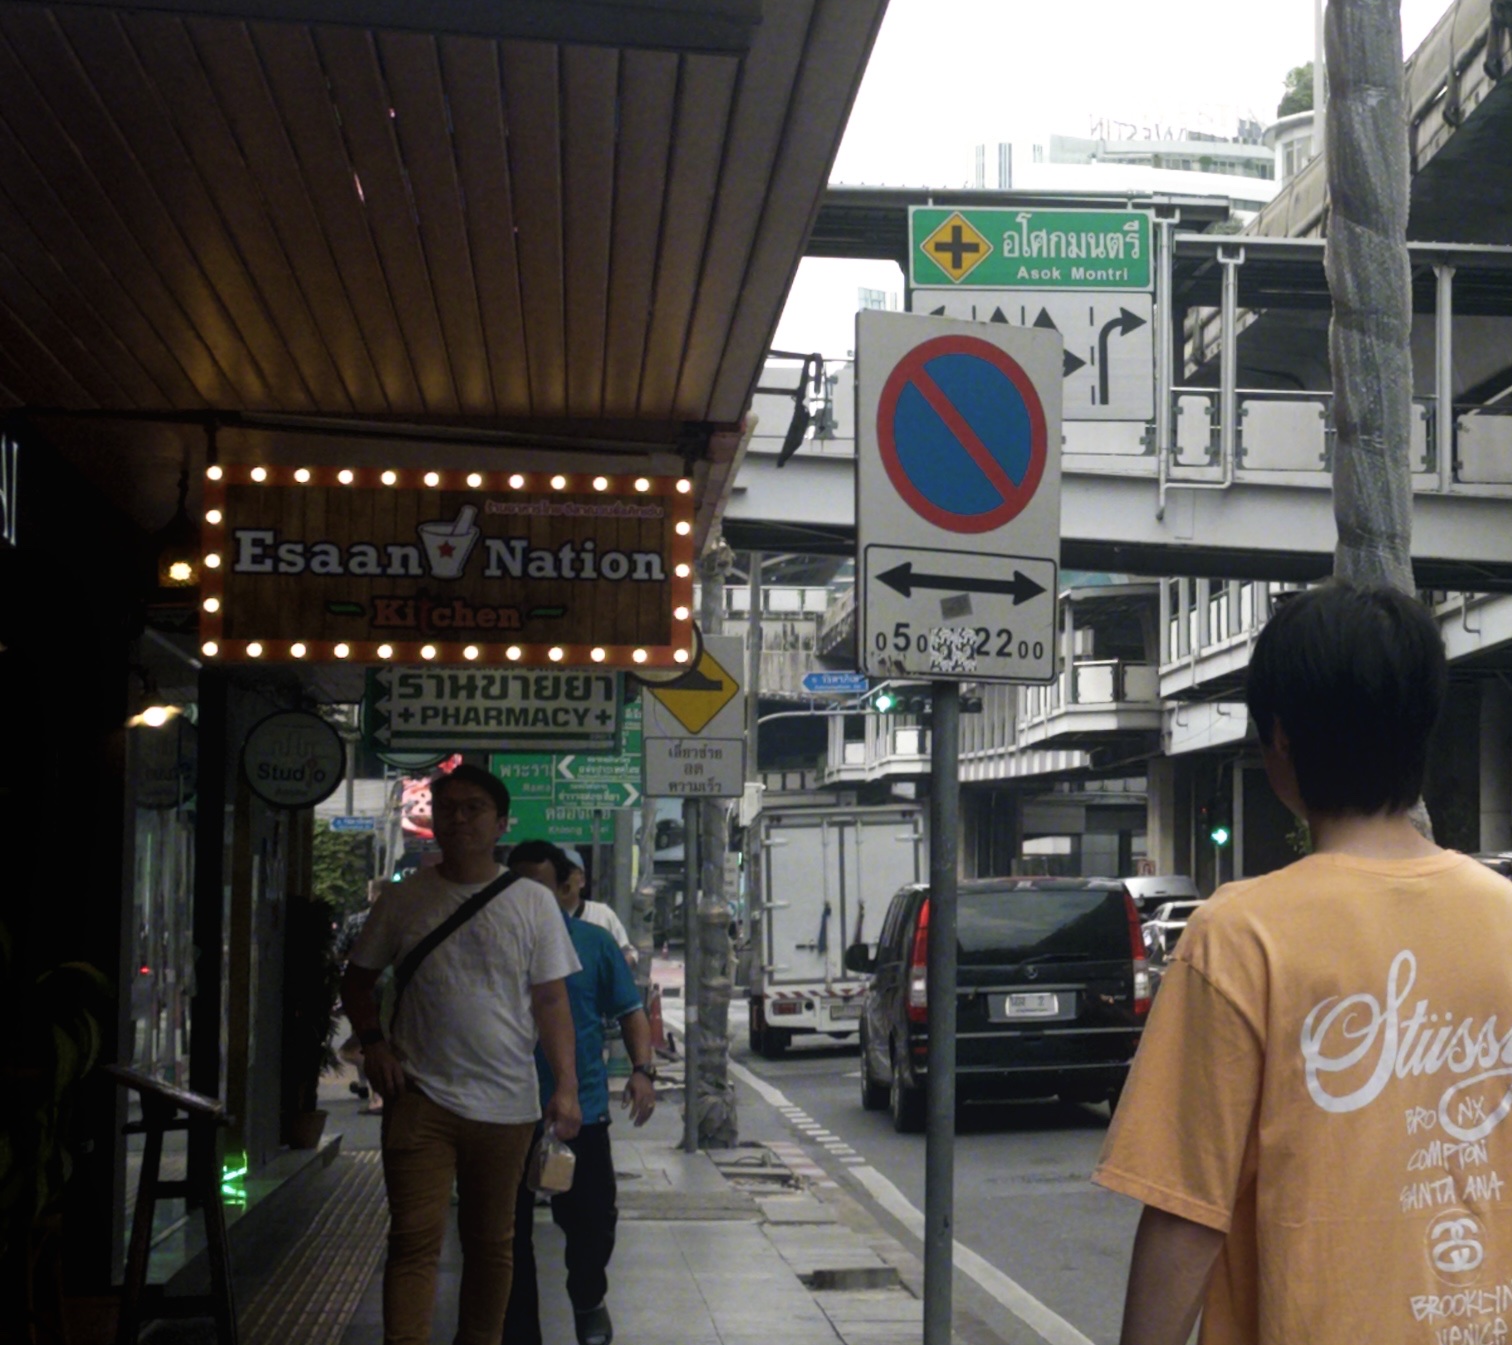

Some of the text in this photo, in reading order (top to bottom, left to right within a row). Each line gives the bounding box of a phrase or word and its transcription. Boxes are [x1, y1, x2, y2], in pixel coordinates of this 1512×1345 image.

[1002, 212, 1140, 259] อโศกมนตรี
[1017, 266, 1129, 281] Asok Montri
[233, 529, 667, 582] Esaan Nation
[373, 592, 521, 632] Kitchen
[398, 674, 614, 702] รานขายยา
[420, 706, 591, 728] PHARMACY
[545, 807, 612, 821] คลองเย
[1406, 1138, 1489, 1172] COMPTON
[1399, 1170, 1505, 1213] SANTA ANA
